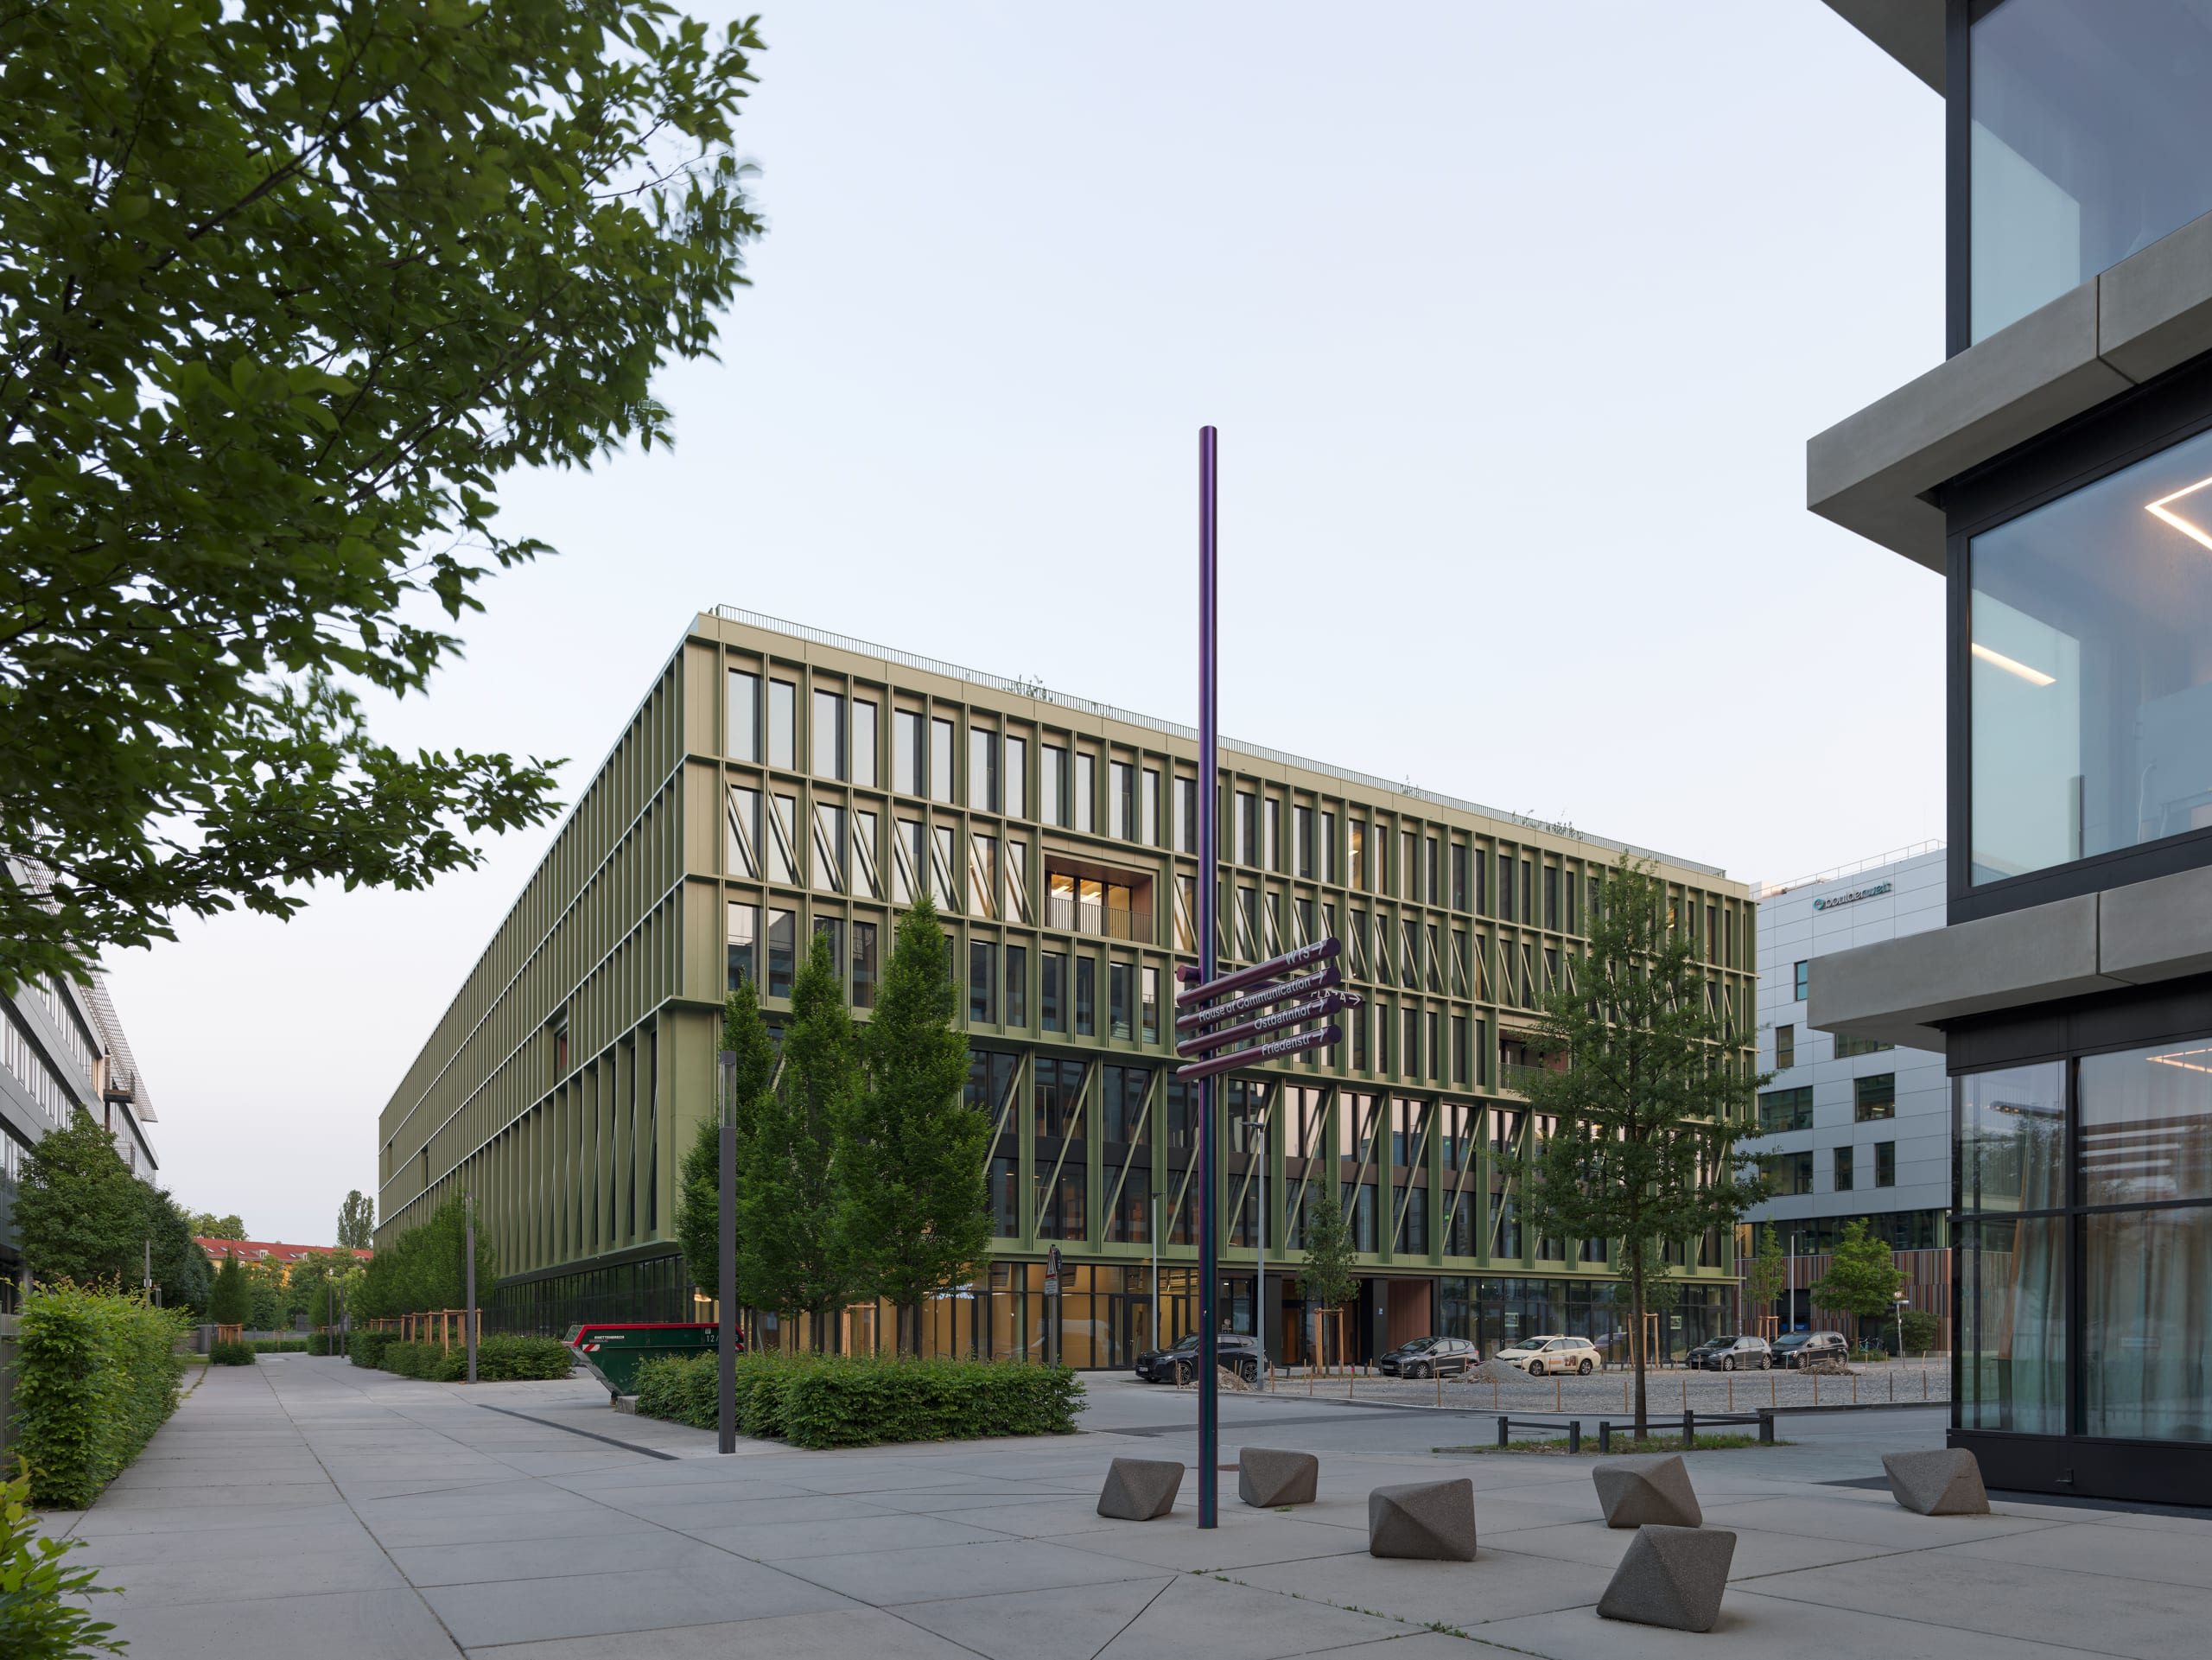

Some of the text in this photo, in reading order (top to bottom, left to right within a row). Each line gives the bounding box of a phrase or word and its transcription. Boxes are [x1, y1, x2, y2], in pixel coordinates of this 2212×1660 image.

[1286, 946, 1310, 965] WTS
[1198, 977, 1311, 1022] House of Communication
[1254, 1002, 1312, 1030] Ostbahnhof
[1262, 1034, 1311, 1056] Friedenstr
